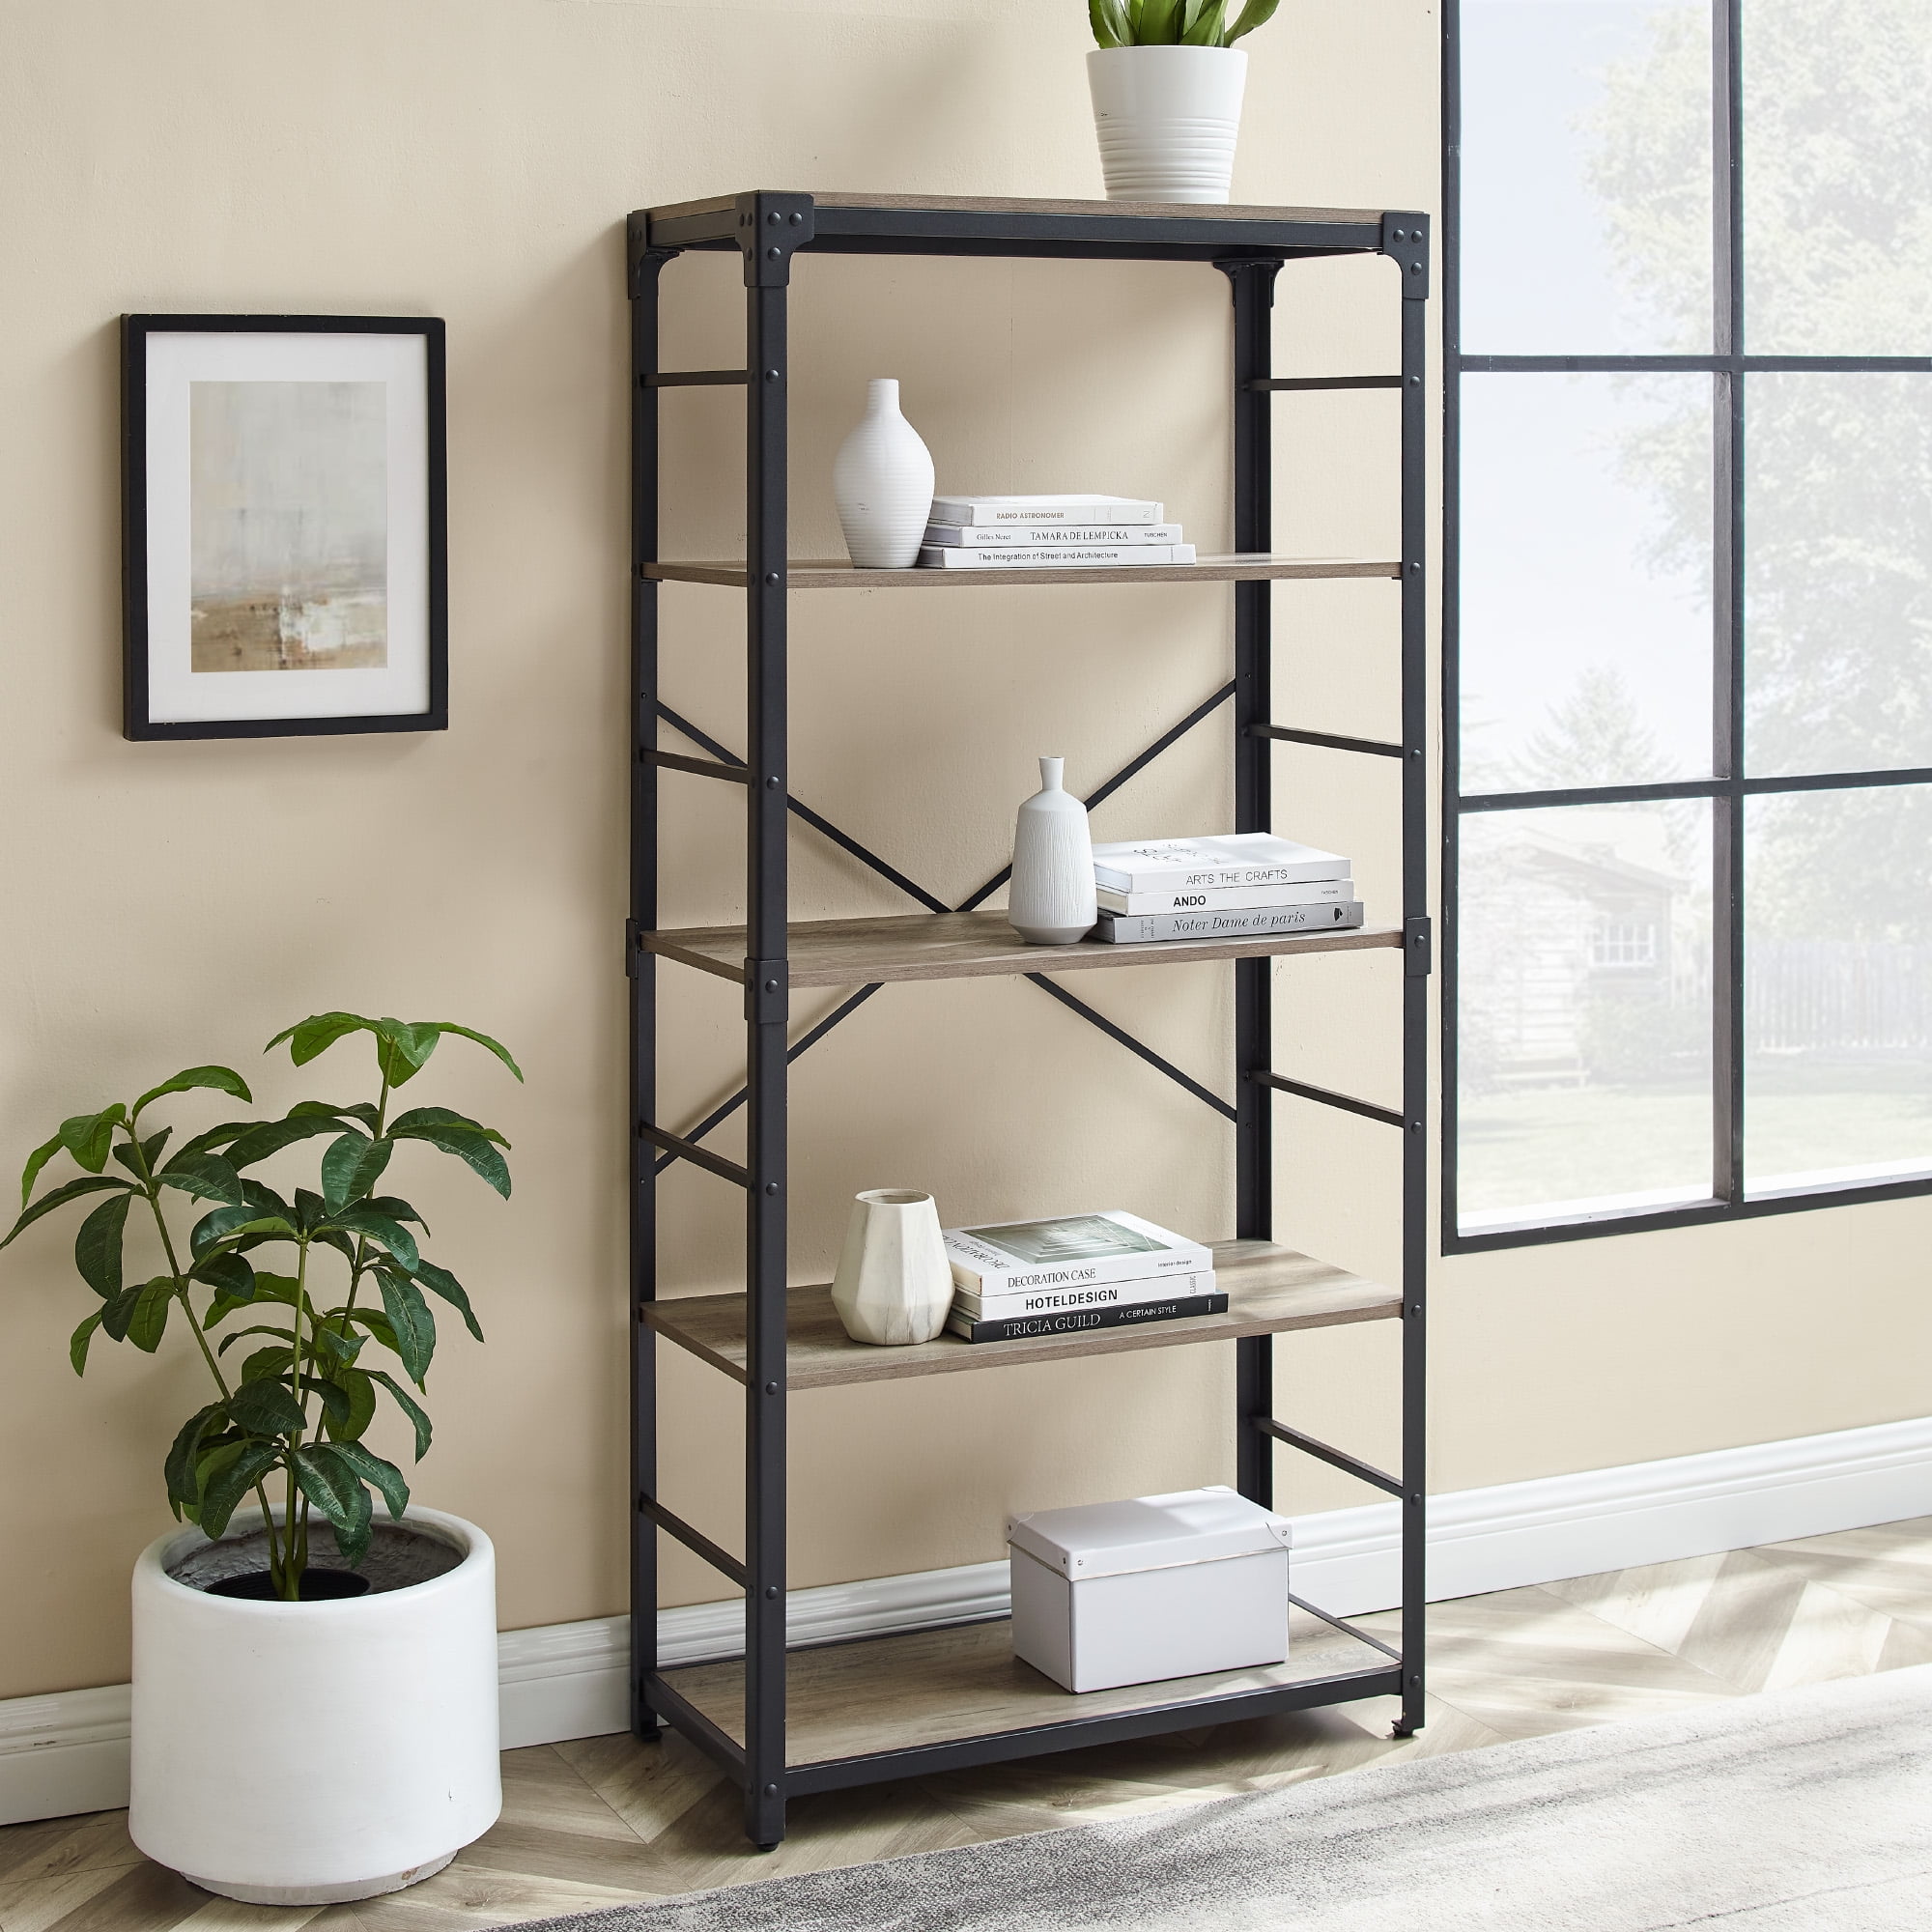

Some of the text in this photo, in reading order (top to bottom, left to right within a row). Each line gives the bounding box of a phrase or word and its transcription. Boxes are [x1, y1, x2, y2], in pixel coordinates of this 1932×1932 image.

[1030, 531, 1129, 541] TAMARA DE LEMPICKA
[978, 553, 992, 561] The
[993, 553, 1031, 562] Integration
[1039, 552, 1062, 560] Street
[1185, 868, 1288, 886] ARTS THE CRAFTS
[1173, 895, 1207, 907] ANDO
[1172, 911, 1306, 933] Noter Dame de paris
[1008, 1268, 1096, 1288] DECORATION CASE
[1026, 1290, 1118, 1310] HOTELDESIGN
[1119, 1305, 1177, 1320] A CERTAIN STYLE
[1003, 1314, 1101, 1337] TRICIA GUILD
